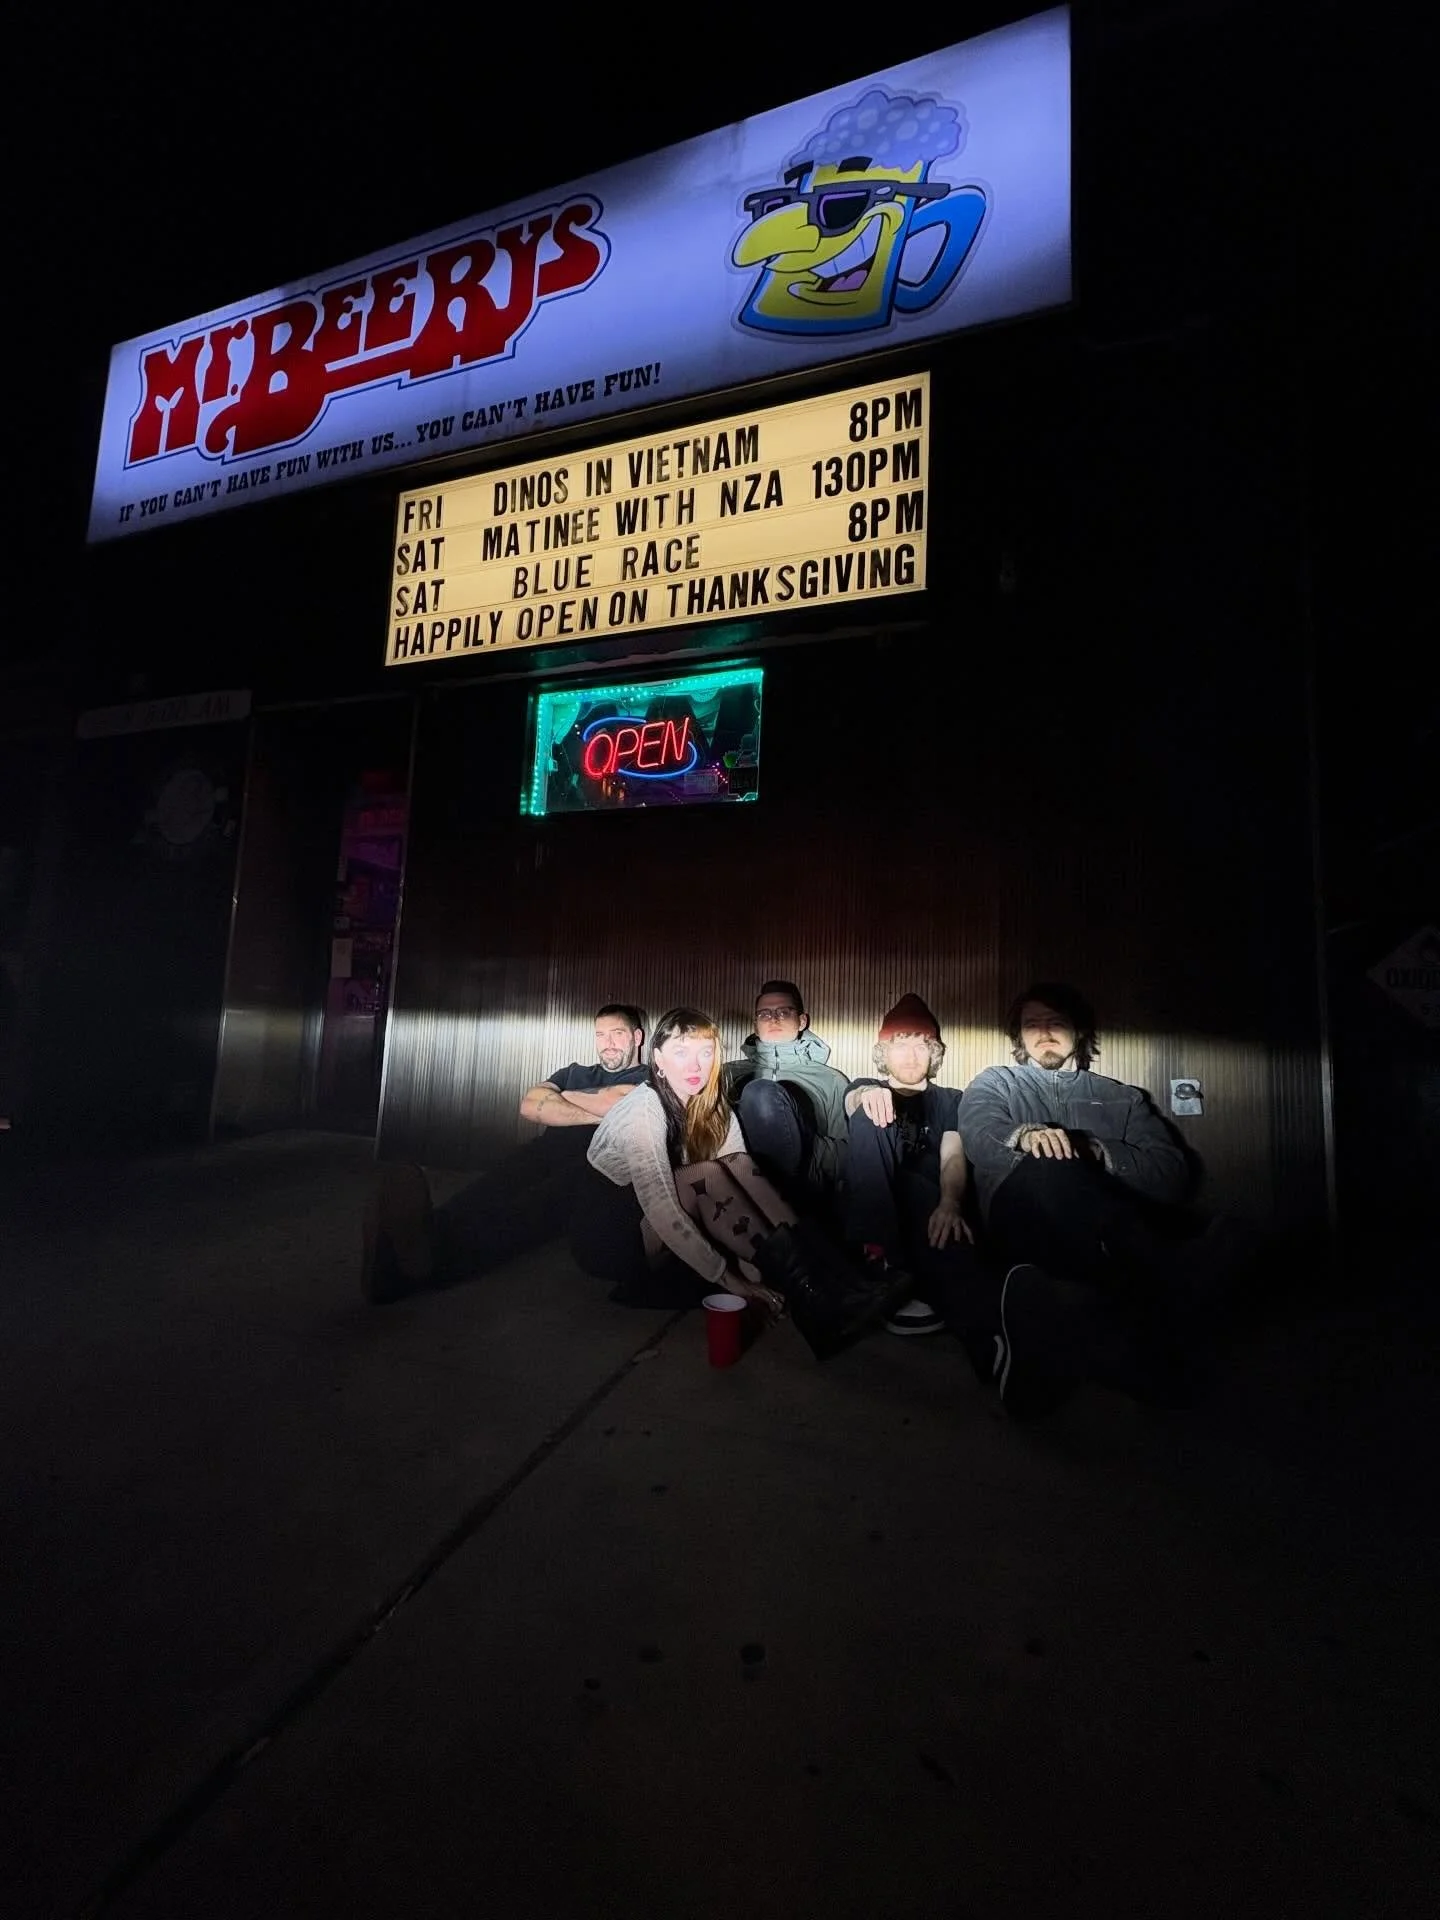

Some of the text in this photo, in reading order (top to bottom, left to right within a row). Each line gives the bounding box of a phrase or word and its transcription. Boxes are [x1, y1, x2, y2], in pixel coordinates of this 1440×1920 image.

[118, 505, 134, 522] IF
[140, 495, 167, 517] YOU
[173, 480, 221, 508] CAN'T
[227, 467, 270, 493] HAVE
[275, 457, 311, 480] FUN
[317, 440, 364, 469] WITH
[462, 397, 528, 432] CAN'T
[534, 379, 595, 413] HAVE
[604, 362, 661, 396] FUN!
[396, 439, 920, 576] SAT MATINEE WITH NZA 130PM
[403, 388, 922, 533] FRI DINOS IN VIETNAM 8PM
[393, 543, 915, 659] HAPPILY OPEN ON THANKSGIVING
[395, 490, 924, 617] SAT BLUE RACE 8PM
[584, 717, 690, 778] OPEN
